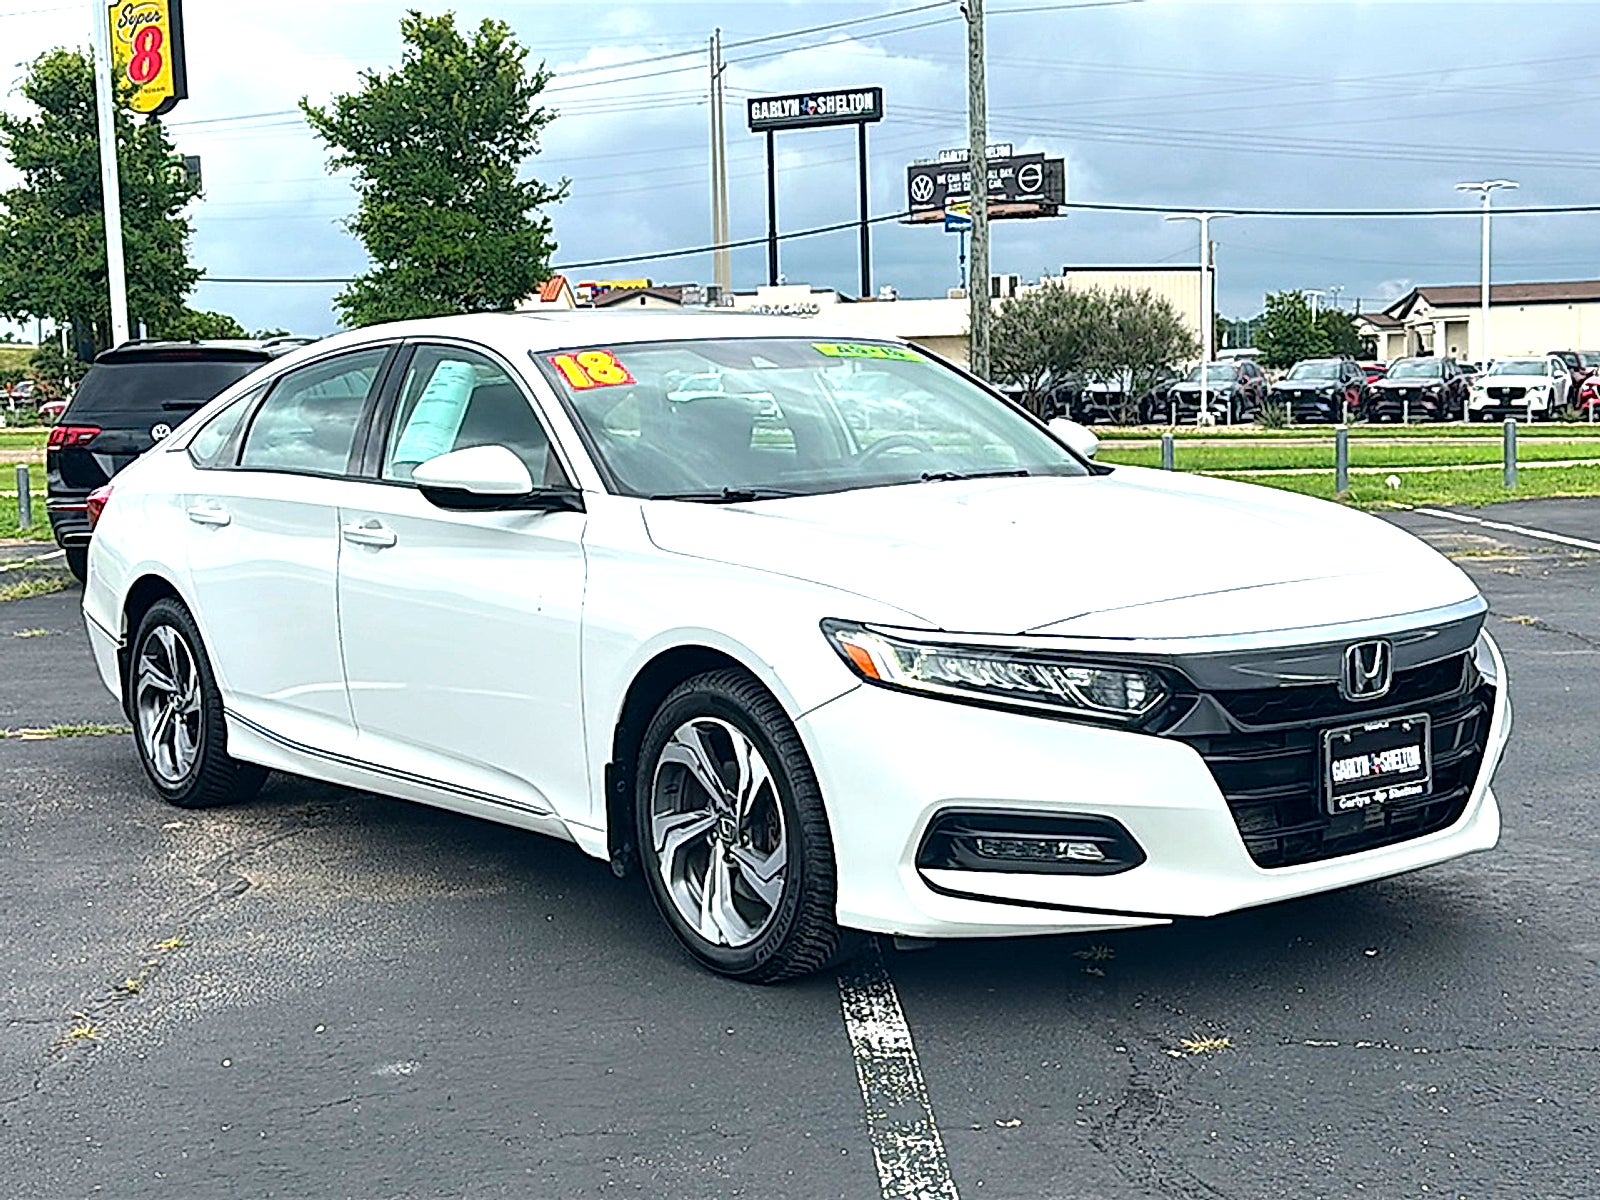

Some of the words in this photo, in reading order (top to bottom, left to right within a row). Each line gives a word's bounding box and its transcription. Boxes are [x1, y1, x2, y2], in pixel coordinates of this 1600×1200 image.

[117, 3, 163, 38] Super
[128, 25, 163, 85] 8
[816, 92, 874, 115] SHELTON
[554, 350, 628, 389] 18
[1379, 745, 1422, 773] SHELTON
